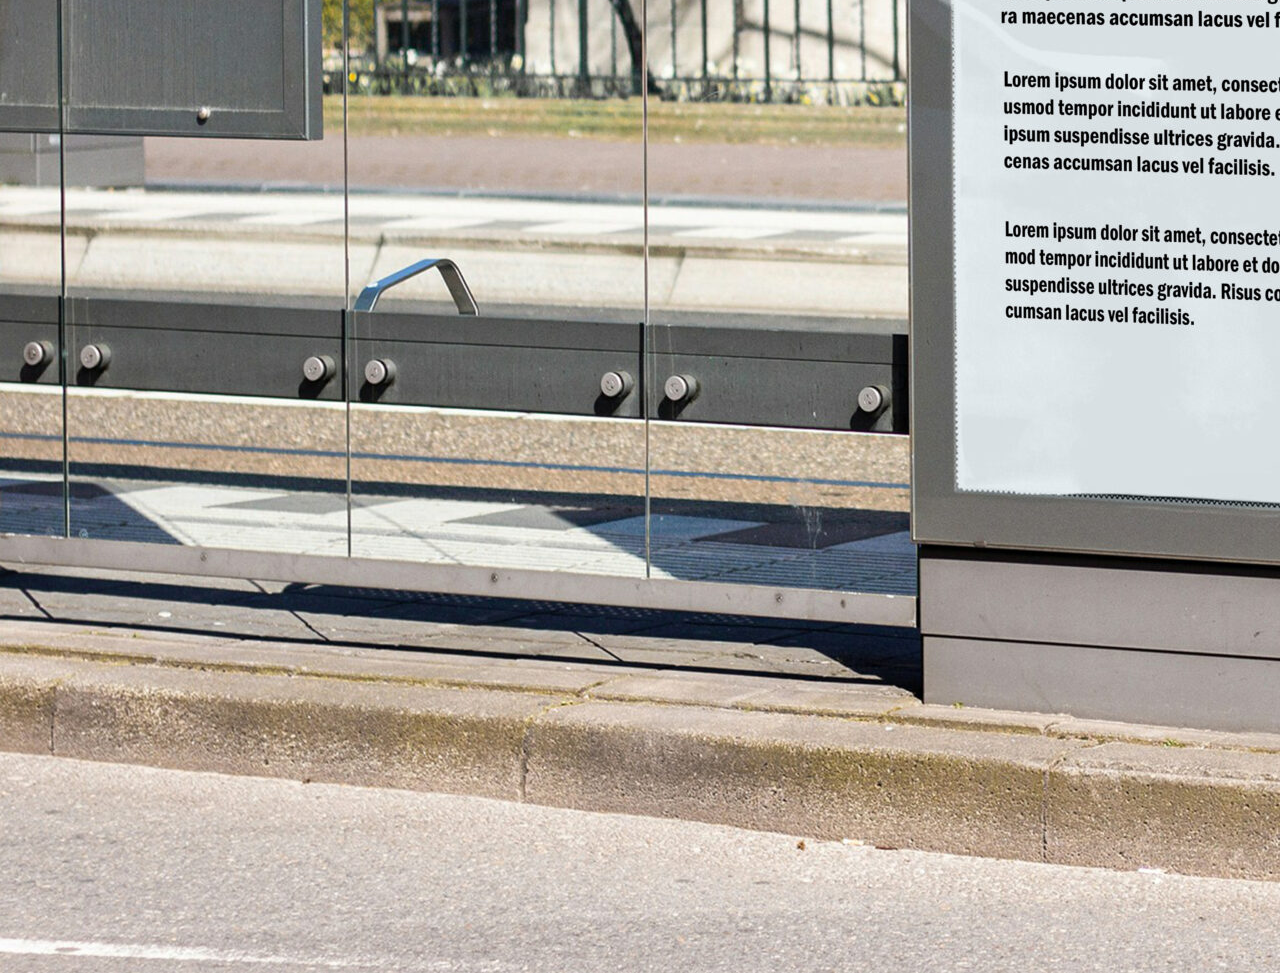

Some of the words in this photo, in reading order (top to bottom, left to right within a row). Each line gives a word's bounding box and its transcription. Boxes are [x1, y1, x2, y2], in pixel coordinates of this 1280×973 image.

[1001, 10, 1018, 25] ra
[1022, 11, 1106, 26] maecenas
[1109, 12, 1194, 27] accumsan
[1198, 10, 1243, 28] lacus
[1246, 11, 1270, 29] vel
[1003, 70, 1051, 89] Lorem
[1054, 71, 1102, 93] ipsum
[1104, 72, 1146, 91] dolor
[1148, 73, 1169, 91] sit
[1172, 75, 1217, 95] amet,
[1003, 98, 1055, 116] usmod
[1057, 99, 1114, 120] tempor
[1117, 100, 1197, 120] incididunt
[1200, 103, 1217, 120] ut
[1220, 102, 1271, 121] labore
[1003, 124, 1050, 145] ipsum
[1053, 127, 1150, 148] suspendisse
[1153, 128, 1214, 147] ultrices
[1216, 131, 1280, 152] gravida.
[1003, 155, 1050, 170] cenas
[1053, 157, 1133, 172] accumsan
[1136, 155, 1179, 174] lacus
[1181, 157, 1204, 174] vel
[1207, 156, 1275, 177] facilisis.
[1005, 220, 1049, 239] Lorem
[1052, 221, 1097, 243] ipsum
[1100, 223, 1139, 242] dolor
[1141, 225, 1161, 243] sit
[1163, 227, 1206, 247] amet,
[1005, 248, 1036, 265] mod
[1038, 249, 1092, 270] tempor
[1094, 250, 1170, 271] incididunt
[1172, 254, 1189, 271] ut
[1192, 254, 1240, 273] labore
[1242, 256, 1259, 274] et
[1005, 276, 1095, 296] suspendisse
[1098, 278, 1154, 297] ultrices
[1157, 281, 1217, 302] gravida.
[1221, 282, 1262, 302] Risus
[1005, 305, 1062, 321] cumsan
[1065, 304, 1105, 323] lacus
[1107, 306, 1129, 323] vel
[1131, 306, 1195, 326] facilisis.
